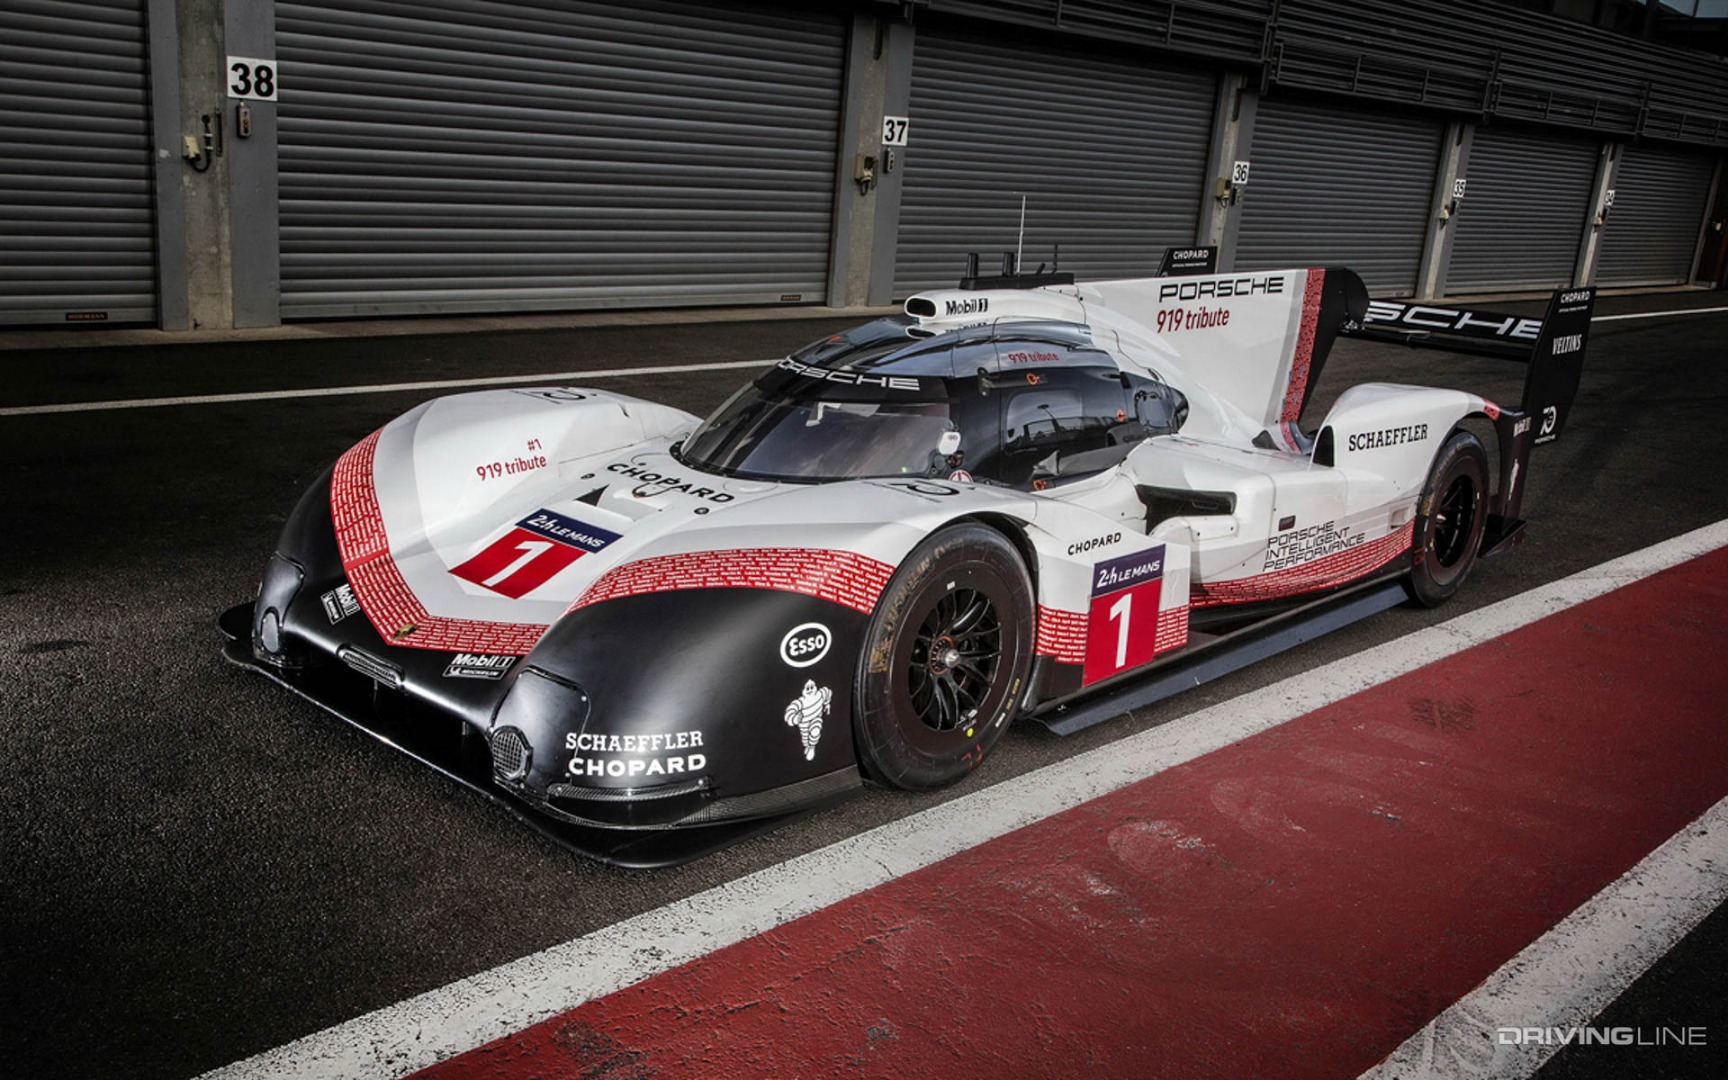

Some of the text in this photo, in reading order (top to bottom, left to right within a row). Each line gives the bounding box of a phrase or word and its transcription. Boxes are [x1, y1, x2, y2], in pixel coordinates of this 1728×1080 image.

[231, 63, 275, 97] 38
[884, 119, 907, 142] 37
[1234, 164, 1249, 181] 36
[1173, 250, 1209, 260] CHOPARD
[1159, 277, 1284, 303] PORSCHE
[1561, 291, 1590, 304] CHOPARD
[1157, 306, 1230, 333] 919 tribute
[1552, 334, 1582, 355] VELTINS
[1008, 352, 1028, 364] 919
[527, 438, 542, 451] #1
[1348, 424, 1428, 451] SCHAEFFLER
[476, 454, 547, 481] 919 tribute
[607, 463, 735, 503] CHOPARD
[567, 530, 606, 548] MANS
[1067, 532, 1122, 556] CHOPARD
[1265, 527, 1350, 560] INTELLIGENT
[1267, 520, 1334, 548] PORSCHE
[481, 540, 555, 587] 1
[1263, 533, 1366, 572] PERFORMANCE
[1118, 570, 1131, 582] LE
[1131, 560, 1161, 578] MANS
[1109, 593, 1132, 668] 1
[789, 634, 825, 656] Esso
[451, 653, 498, 668] Mobil
[565, 730, 704, 753] SCHAEFFLER
[568, 754, 706, 777] CHOPARD
